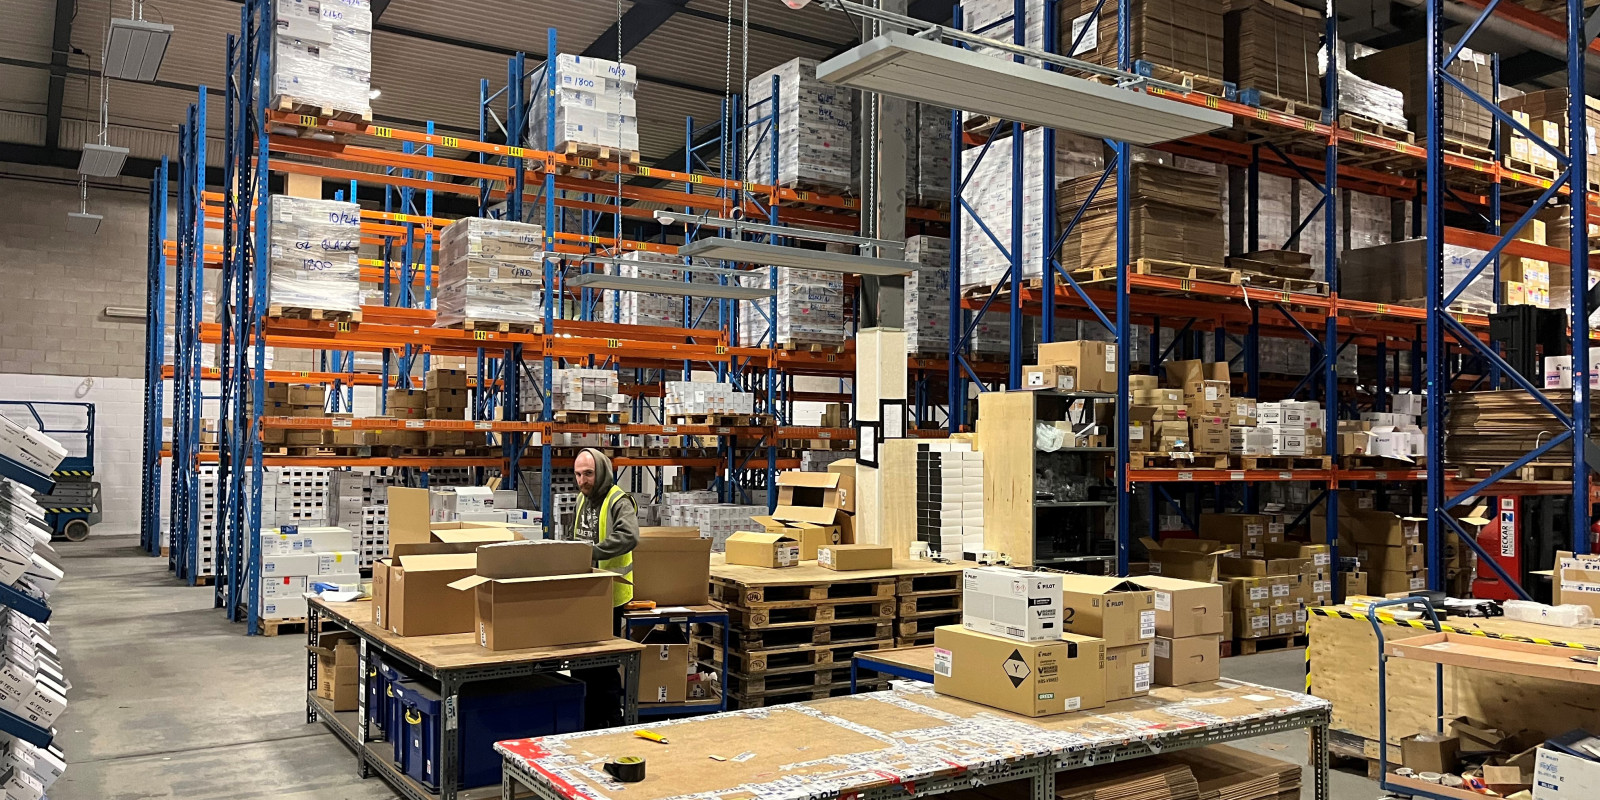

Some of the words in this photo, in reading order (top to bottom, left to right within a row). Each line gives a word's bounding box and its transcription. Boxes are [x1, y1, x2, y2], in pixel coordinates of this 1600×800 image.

[574, 76, 595, 87] 1800
[329, 201, 359, 226] 10/24
[303, 258, 333, 271] 1800
[474, 331, 486, 340] 042
[1013, 664, 1020, 672] Y
[8, 673, 21, 683] PILOT
[38, 694, 52, 704] PILOT
